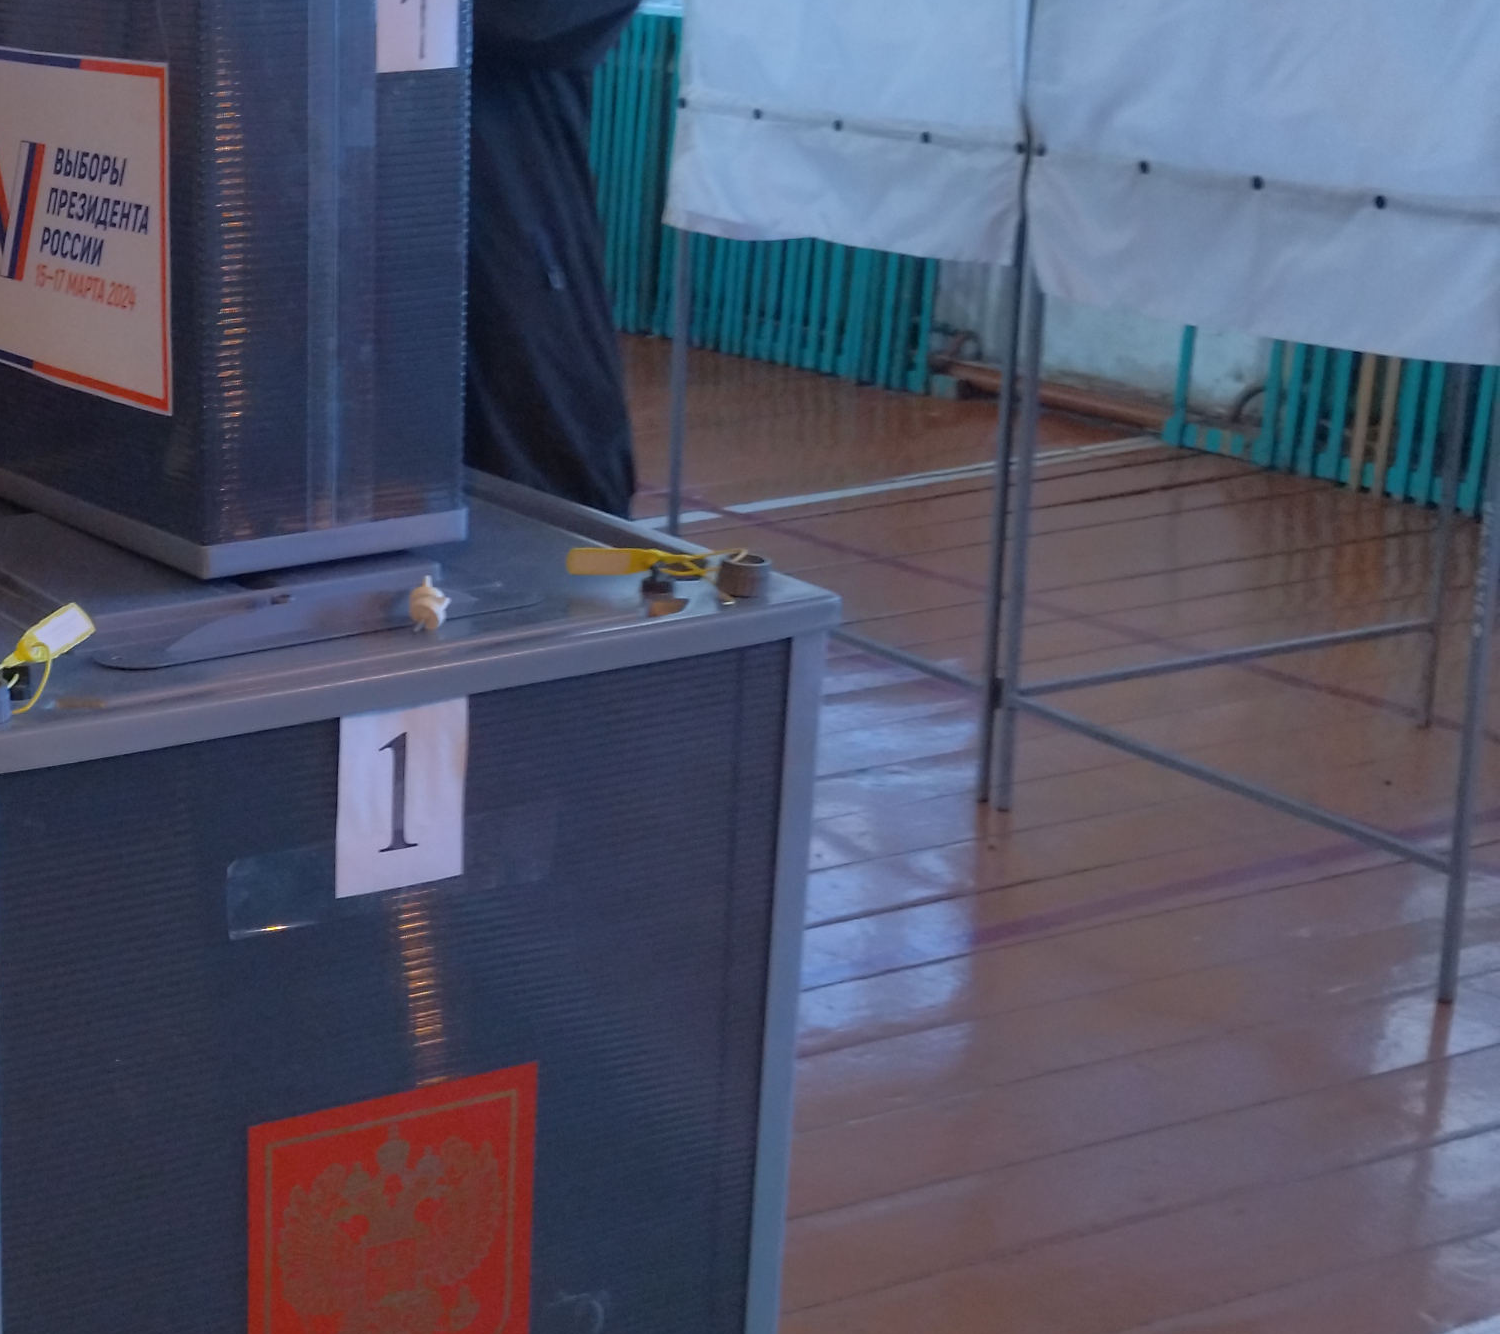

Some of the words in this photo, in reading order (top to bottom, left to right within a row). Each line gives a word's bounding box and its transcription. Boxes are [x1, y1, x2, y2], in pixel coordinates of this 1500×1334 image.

[53, 147, 127, 186] ВЫБОРЫ
[46, 187, 150, 235] ПРЕЗИДЕНТА
[40, 226, 104, 266] РОССИИ
[66, 271, 106, 304] МАРТА
[107, 281, 137, 311] 2024
[378, 731, 419, 853] 1
